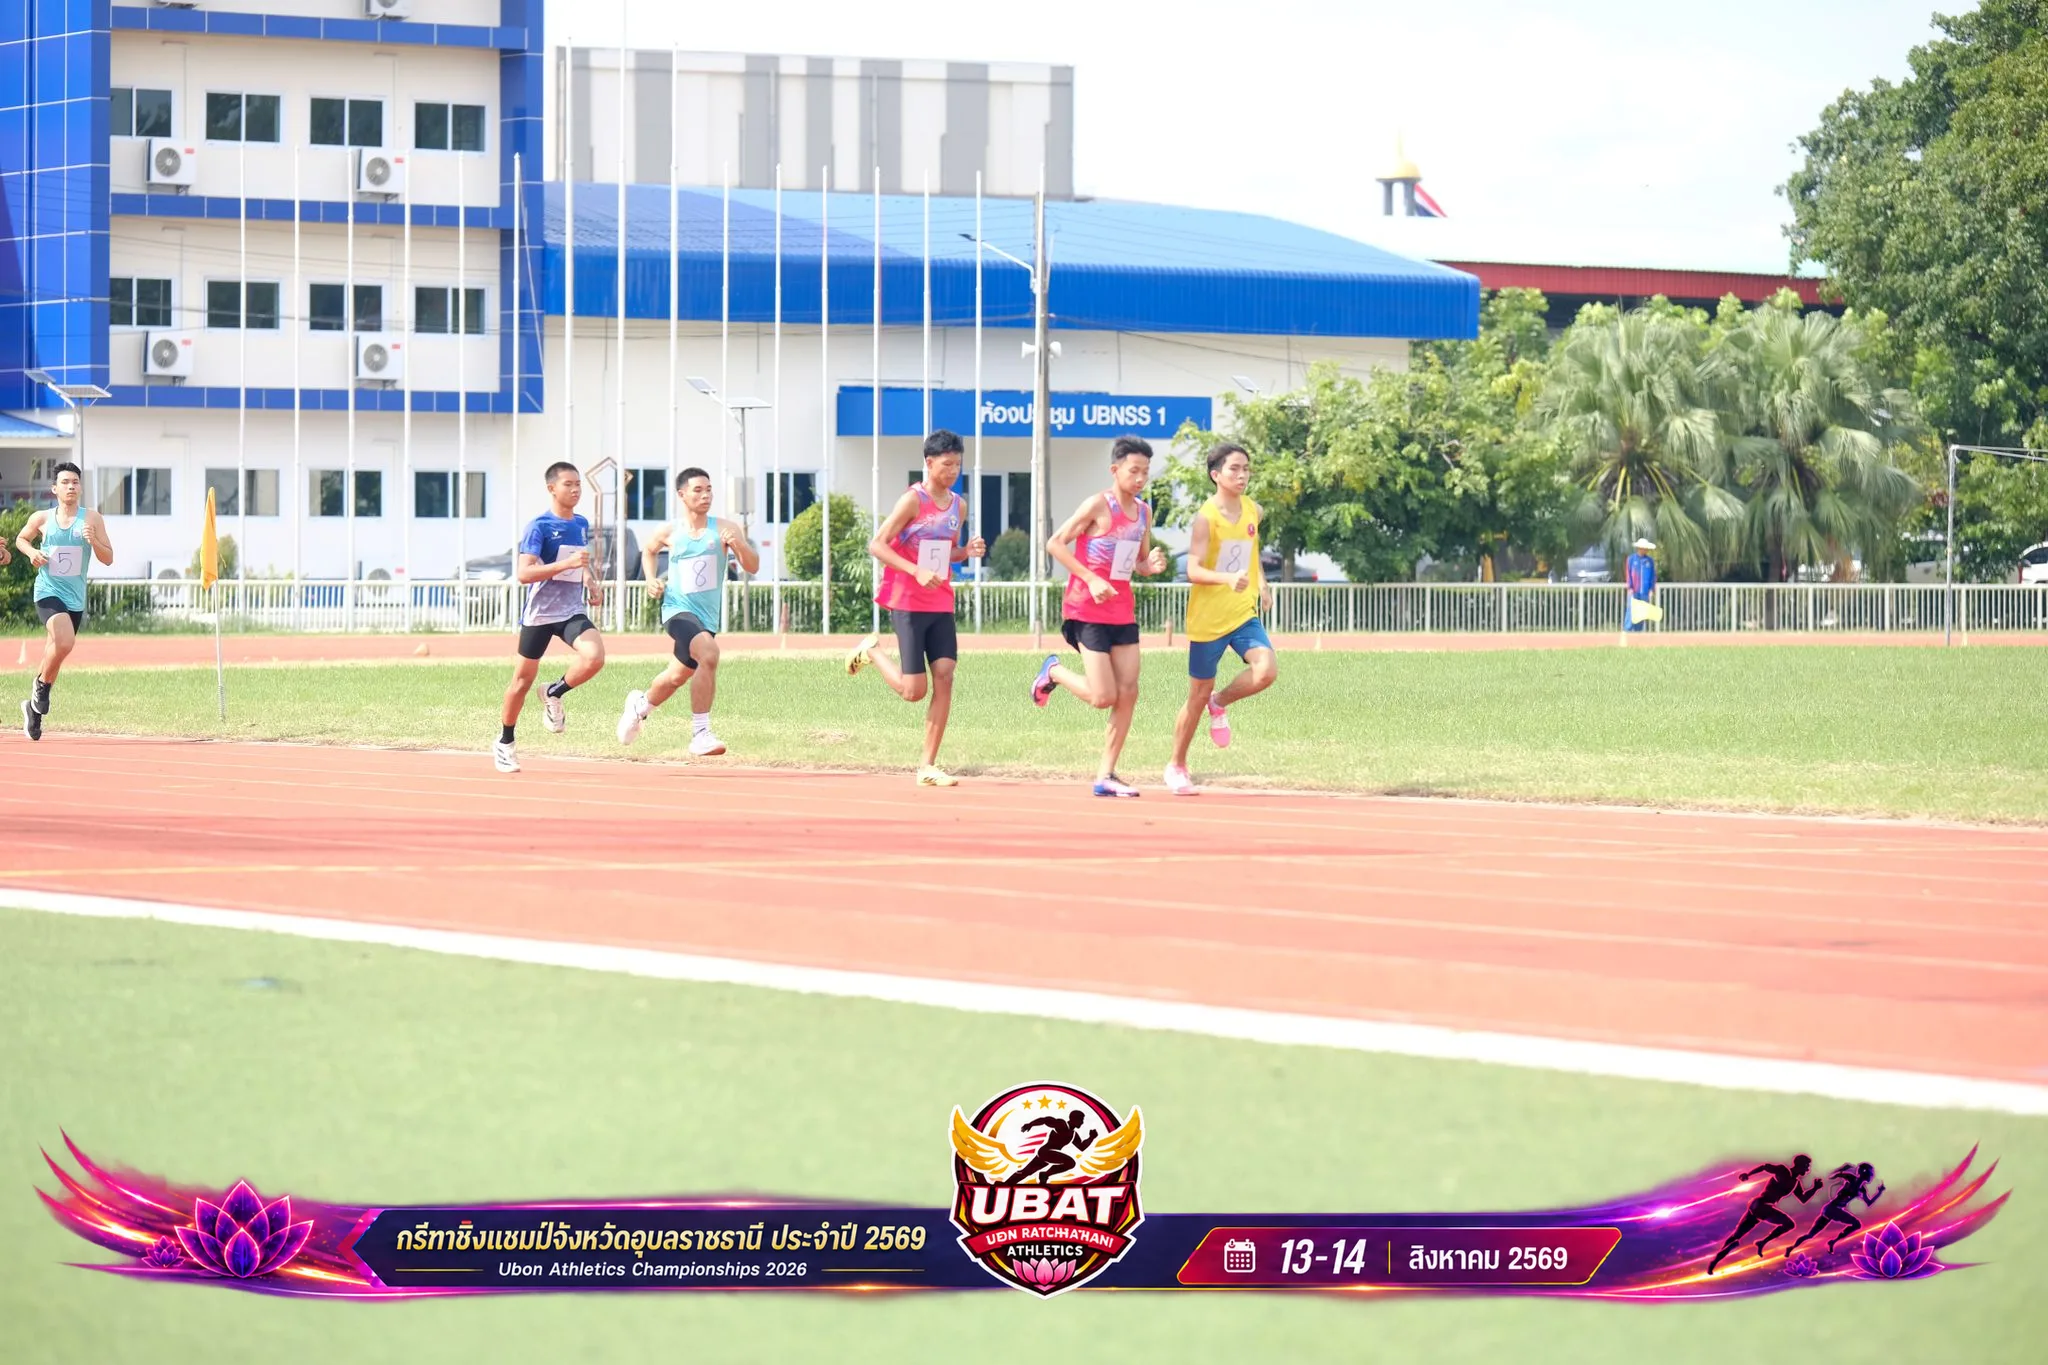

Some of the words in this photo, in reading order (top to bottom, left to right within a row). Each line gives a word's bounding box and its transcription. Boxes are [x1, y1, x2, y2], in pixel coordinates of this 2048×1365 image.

[1083, 405, 1151, 426] UBNSS
[1157, 406, 1166, 426] 1
[58, 552, 73, 575] 5
[930, 548, 942, 573] 5
[1123, 547, 1134, 571] 6
[1226, 544, 1242, 573] 8
[692, 560, 707, 587] 8
